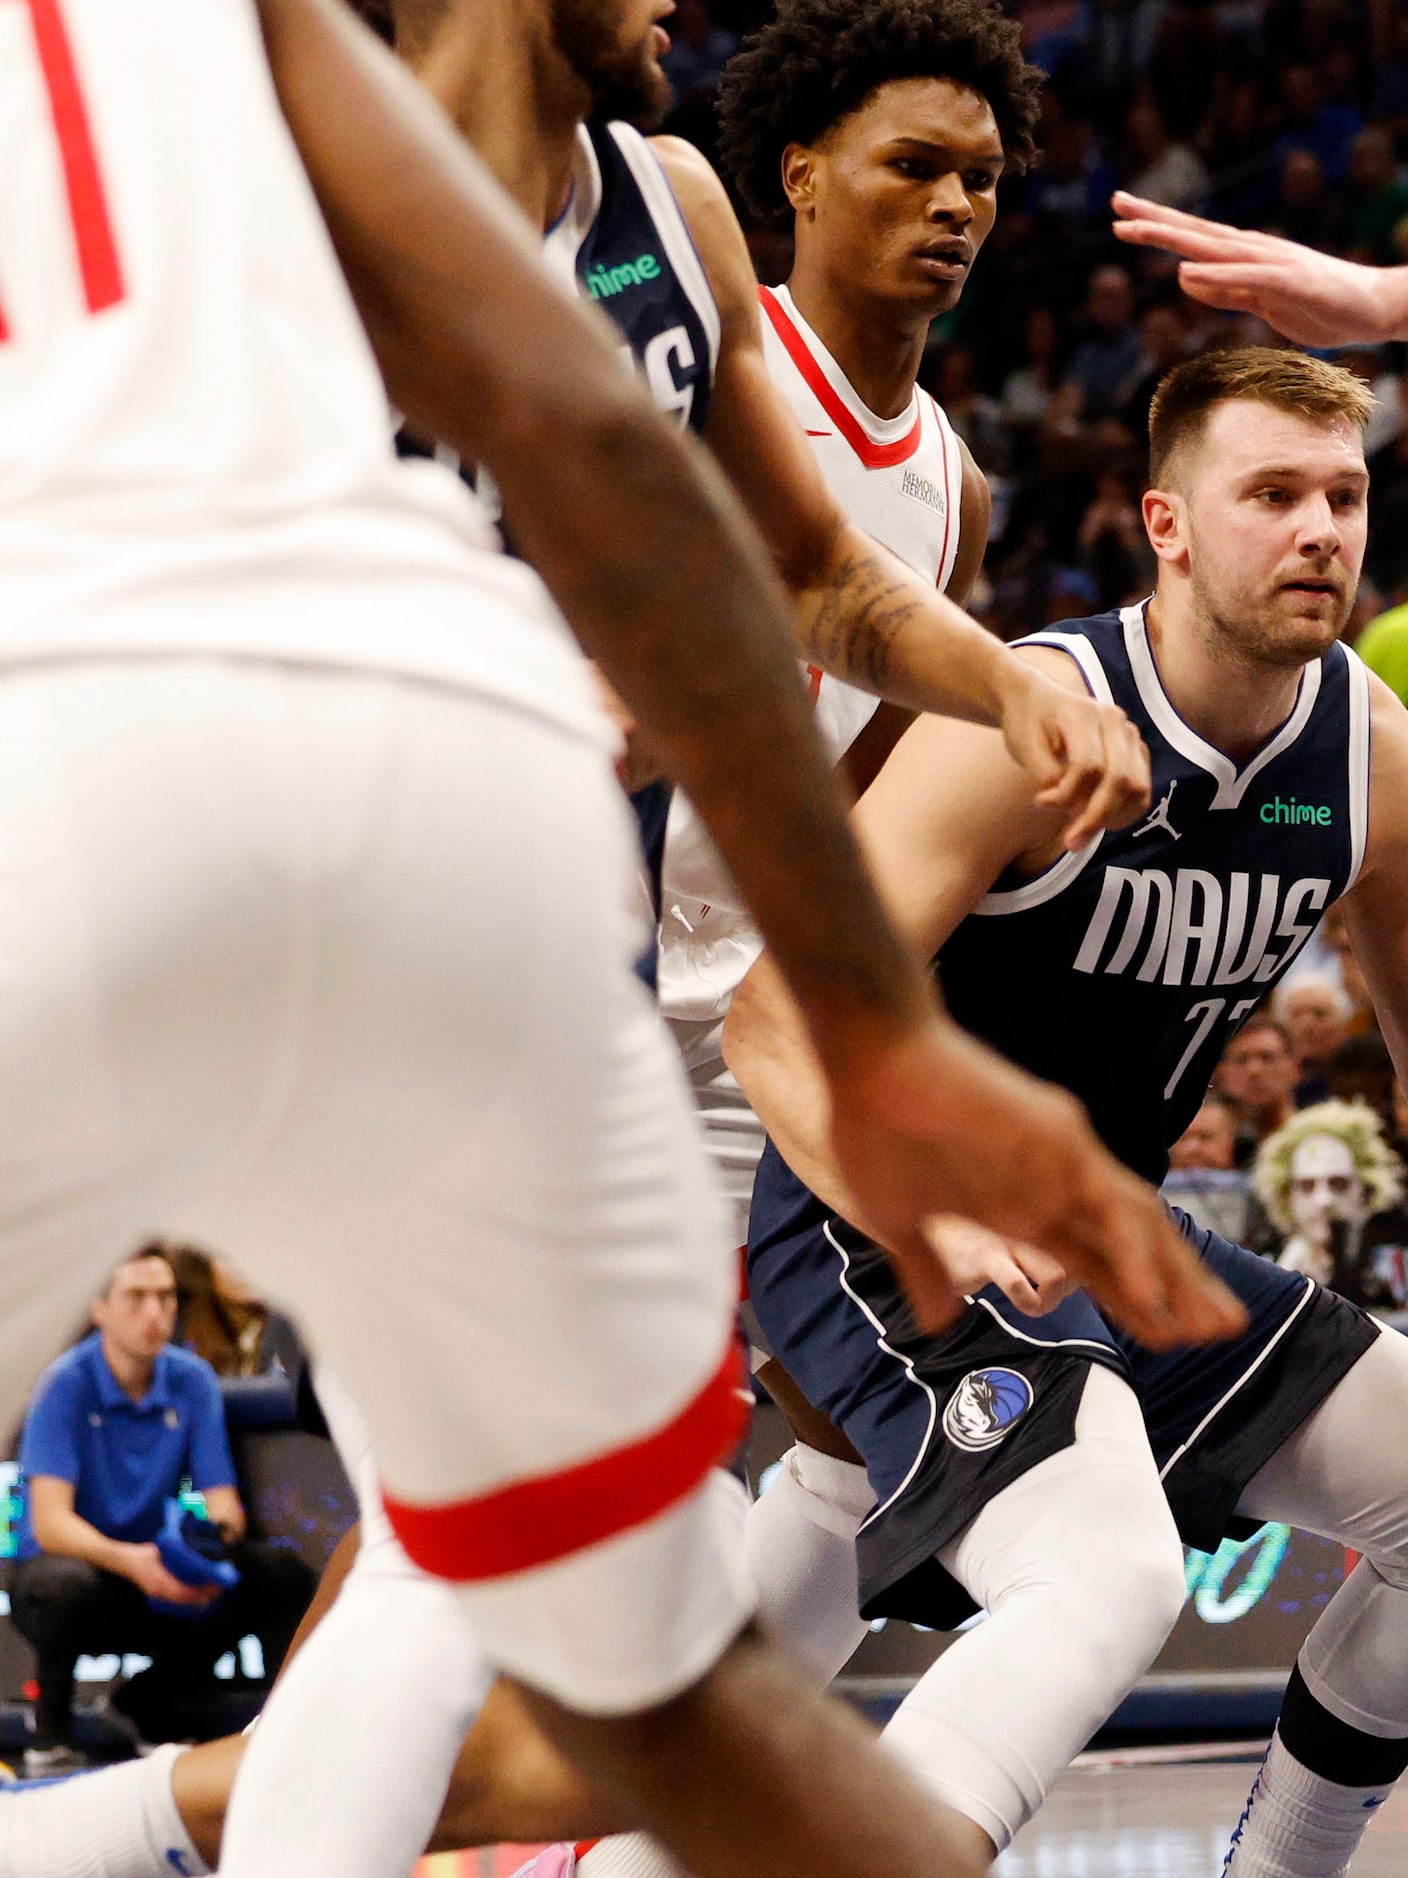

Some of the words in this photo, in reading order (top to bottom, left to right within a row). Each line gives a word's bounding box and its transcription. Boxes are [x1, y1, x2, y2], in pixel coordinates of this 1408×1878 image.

[586, 254, 662, 299] hime
[901, 483, 944, 514] HERMANN
[903, 469, 943, 504] MEMORIAL
[1260, 796, 1332, 826] chime
